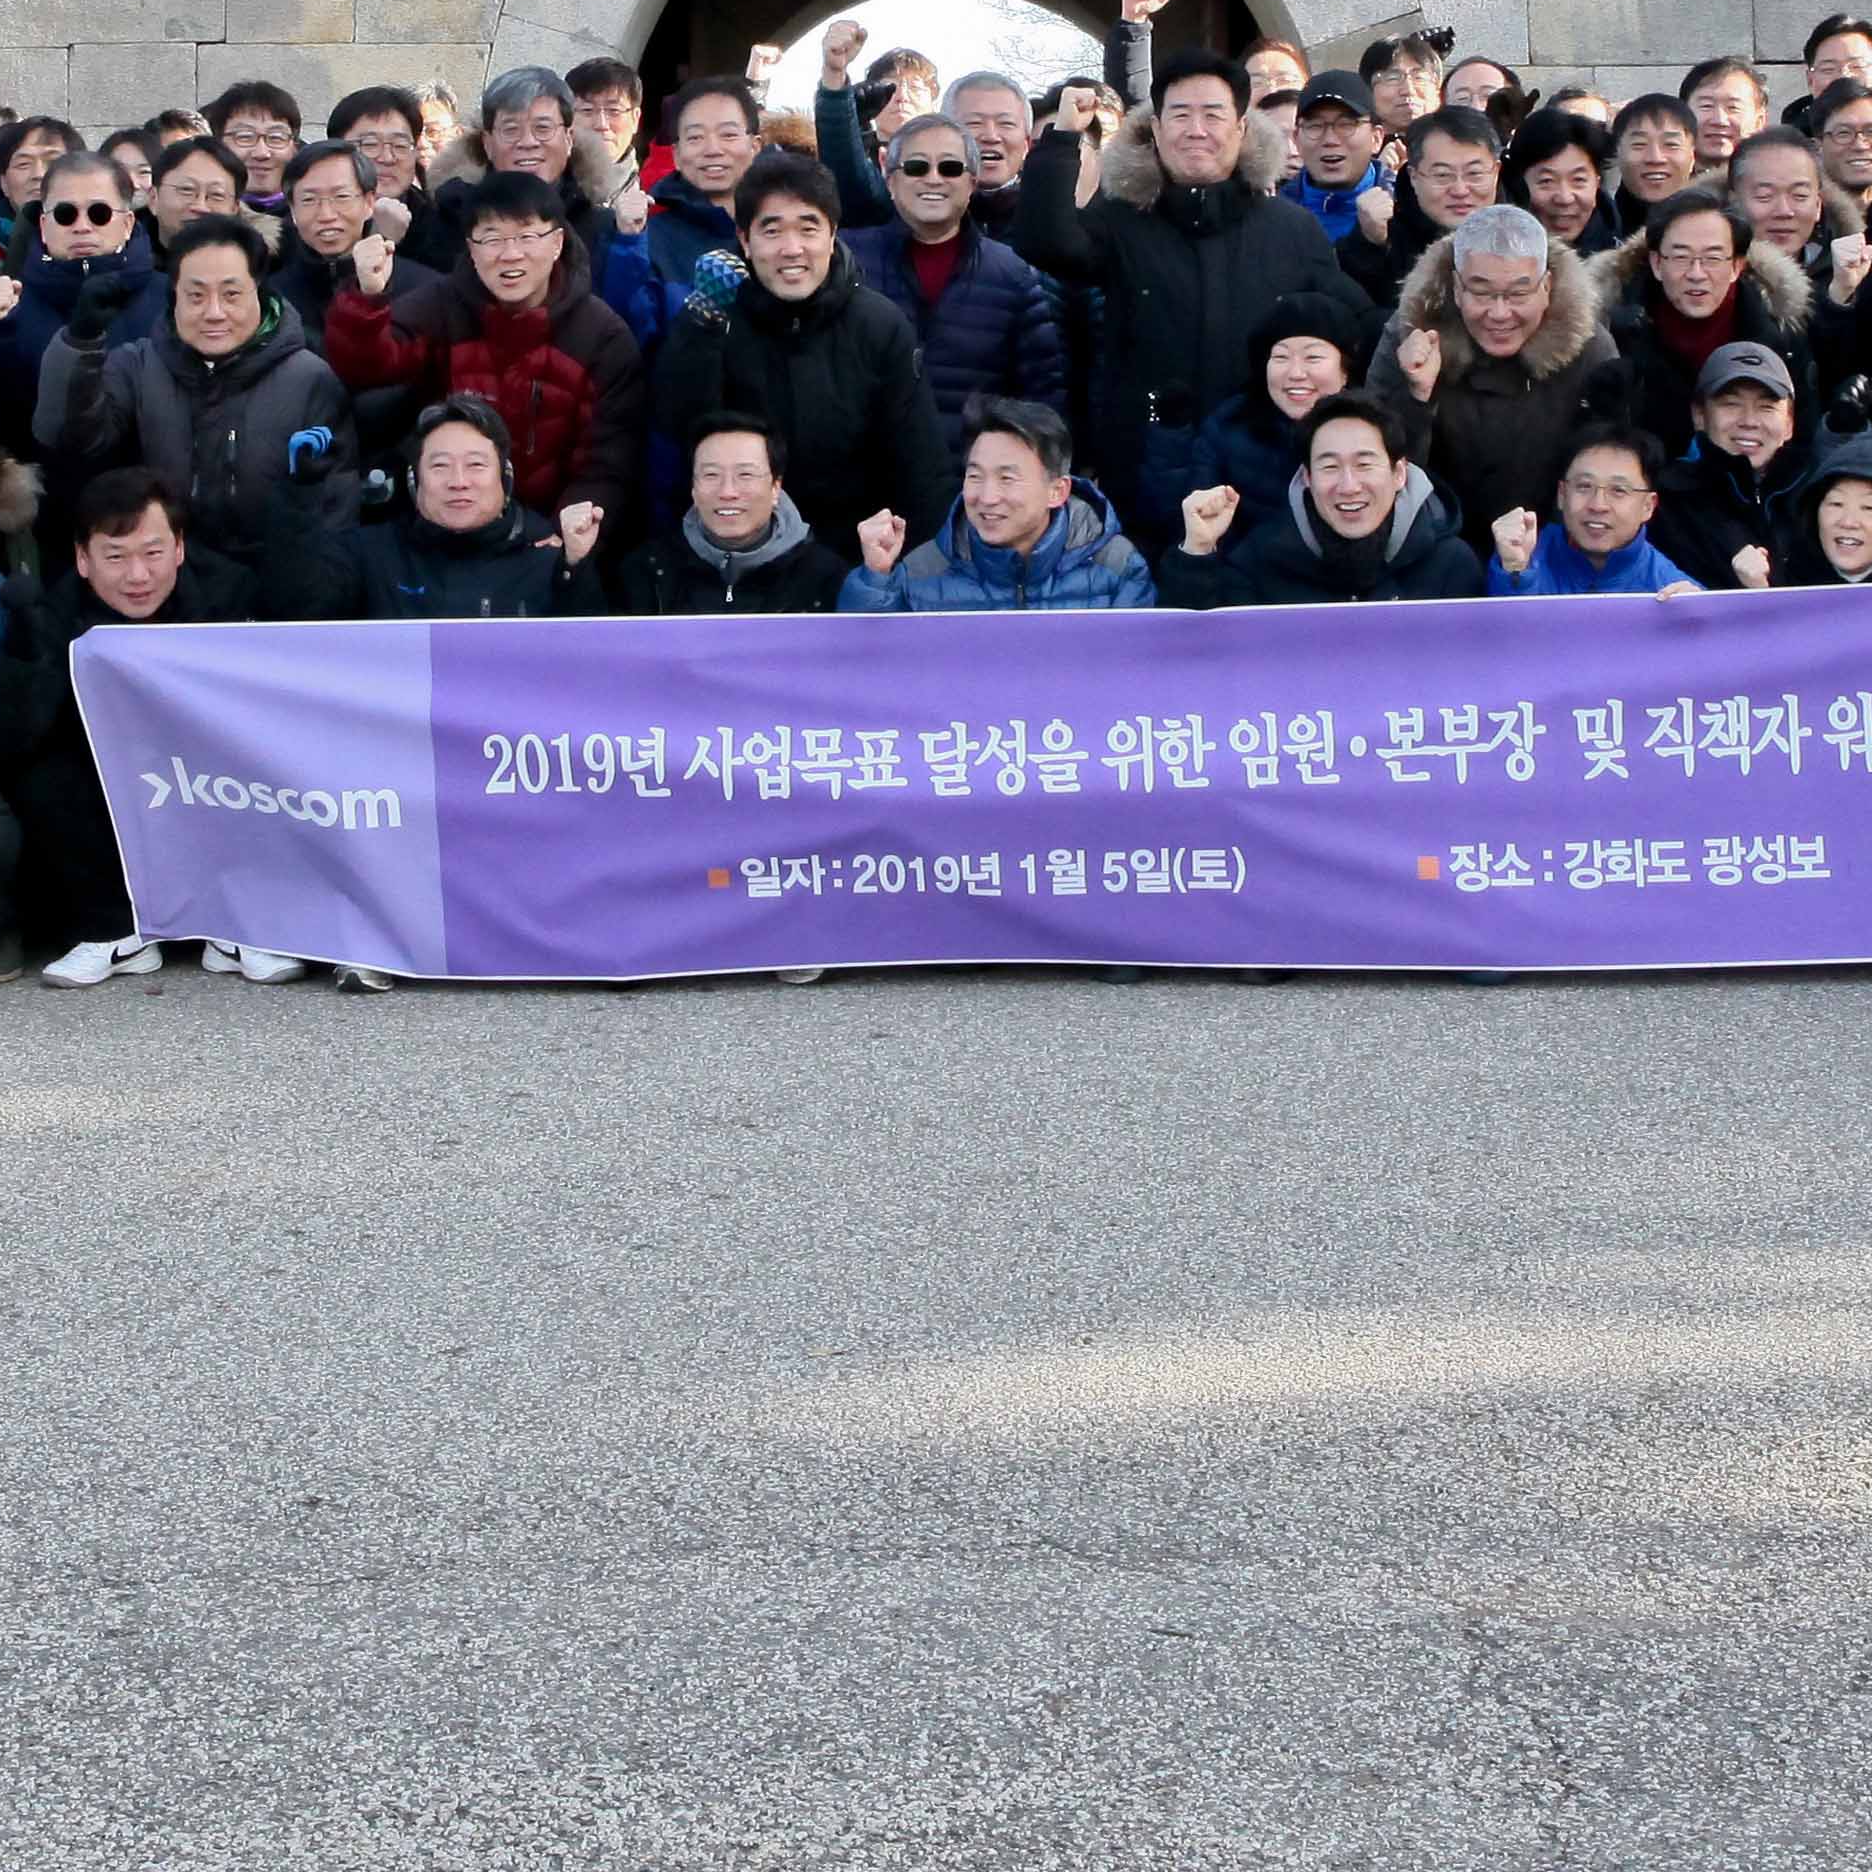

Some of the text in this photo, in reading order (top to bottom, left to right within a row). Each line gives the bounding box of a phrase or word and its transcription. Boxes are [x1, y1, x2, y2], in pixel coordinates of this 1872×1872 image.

[483, 726, 671, 797] 2019년
[683, 725, 908, 801] 사업목표
[918, 718, 1089, 797] 달성을
[1100, 714, 1217, 793] 위한
[1572, 699, 1629, 780] 및
[1643, 694, 1813, 777] 직책자
[167, 757, 401, 830] koscom
[1019, 849, 1087, 895] 1월
[1103, 846, 1246, 894] 5일(토)
[1702, 834, 1831, 886] 광성보
